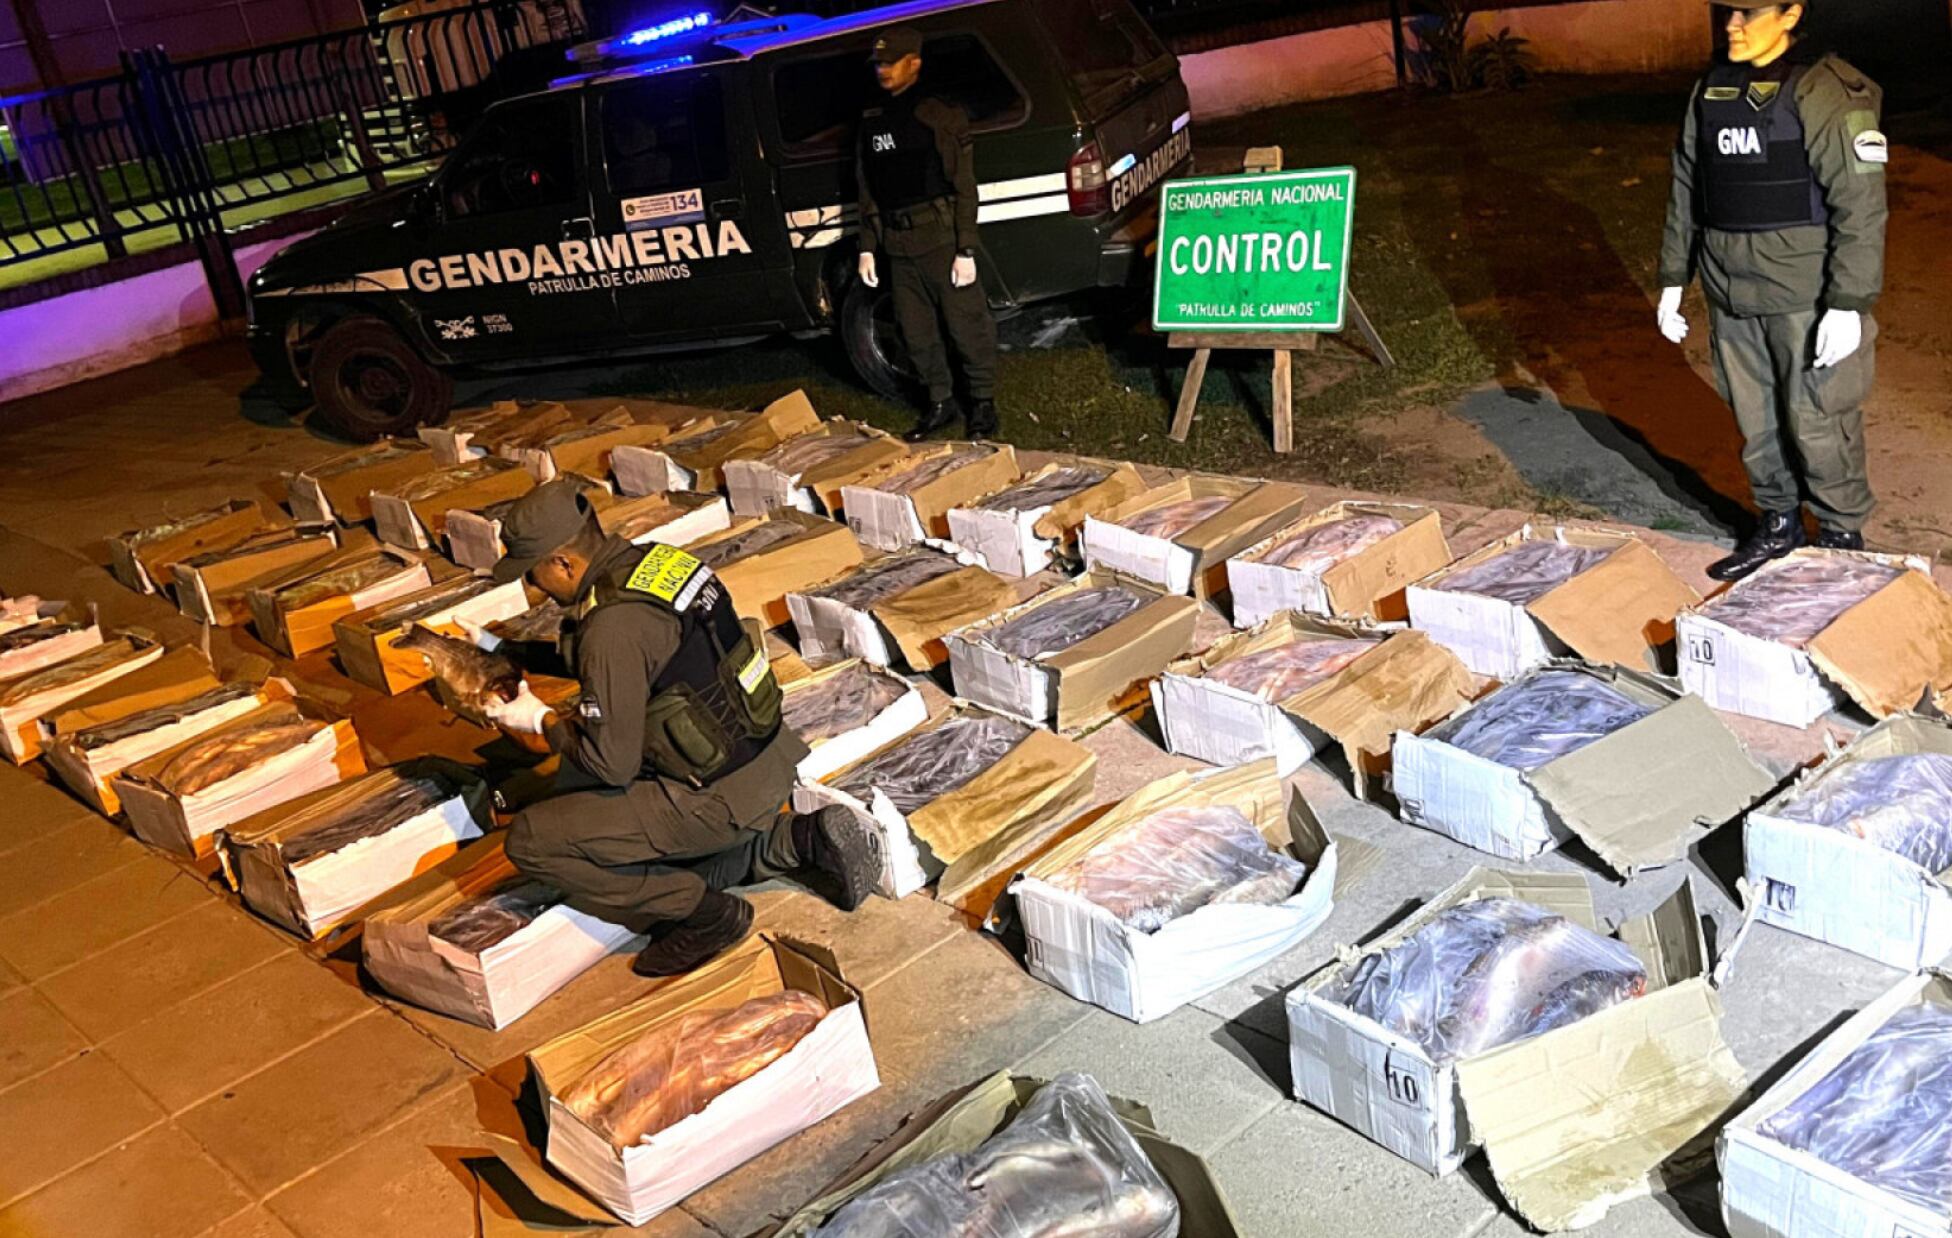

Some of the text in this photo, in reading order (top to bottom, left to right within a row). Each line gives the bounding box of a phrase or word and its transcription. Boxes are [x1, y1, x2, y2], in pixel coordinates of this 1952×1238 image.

[873, 132, 896, 152] GNA
[1718, 126, 1761, 154] GNA
[1111, 127, 1191, 212] GENDARMERIA
[670, 192, 698, 211] 134
[1168, 183, 1345, 212] GENDARMERIA NACIONAL
[409, 220, 752, 292] GENDARMERIA
[1169, 230, 1332, 275] CONTROL
[528, 263, 691, 296] PATRULLA DE CAMINOS
[1240, 303, 1256, 317] DE
